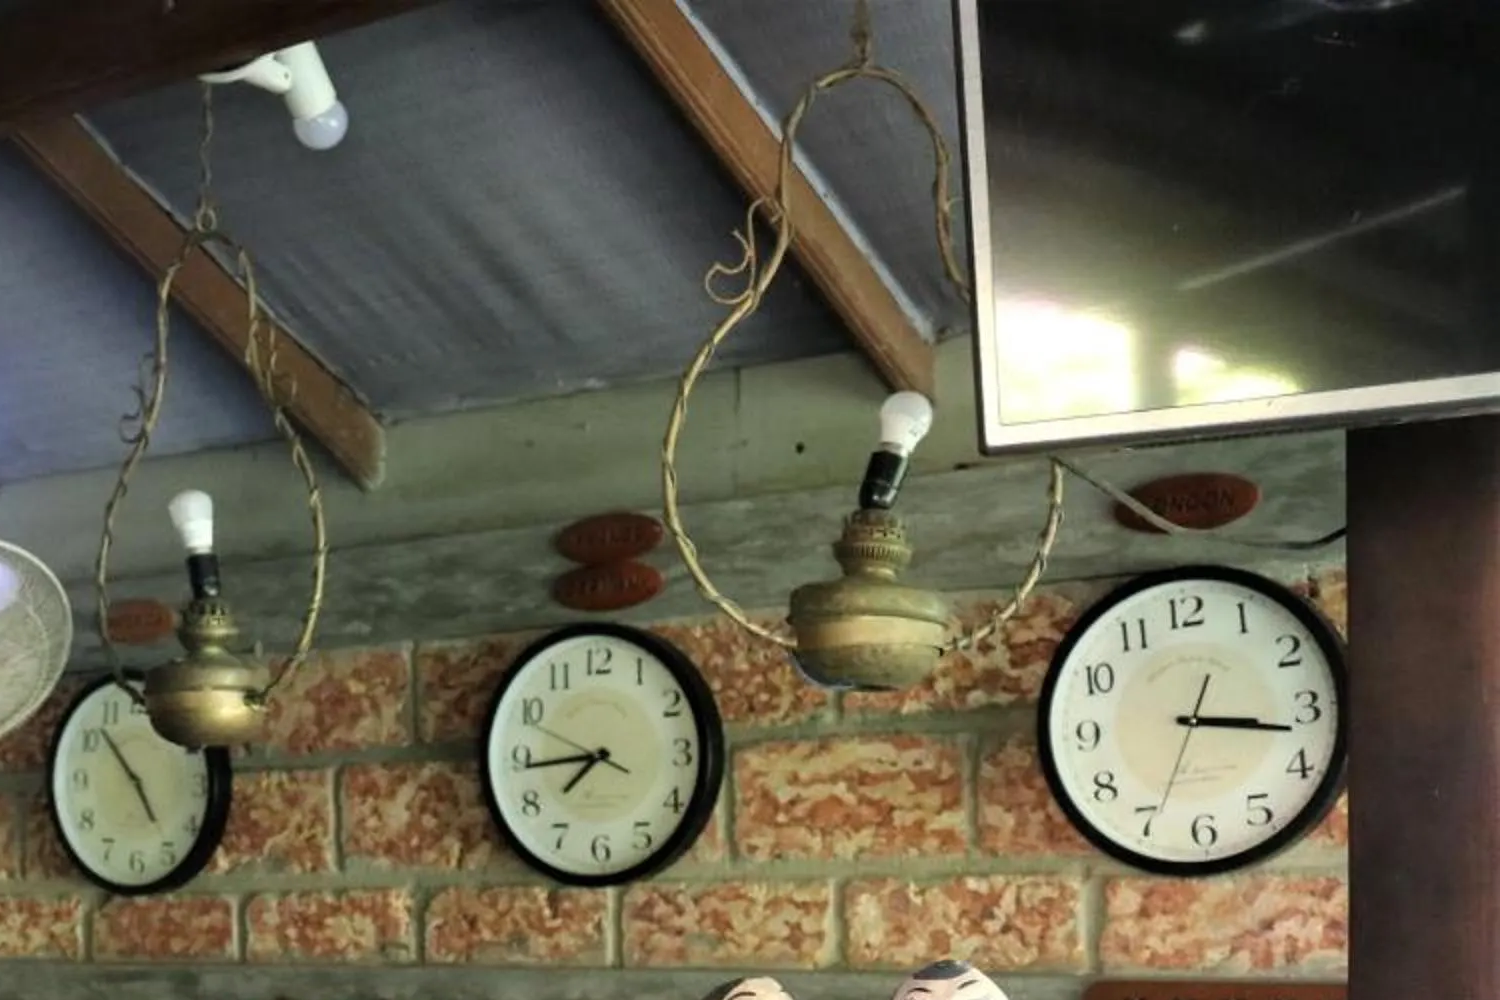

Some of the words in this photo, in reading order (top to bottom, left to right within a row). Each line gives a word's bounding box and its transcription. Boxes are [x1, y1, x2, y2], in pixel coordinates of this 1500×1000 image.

[1170, 596, 1204, 630] 12
[1237, 603, 1248, 634] 1
[1121, 618, 1148, 652] 11
[586, 649, 612, 676] 12
[1275, 634, 1302, 668] 2
[550, 663, 570, 691] 11
[636, 658, 644, 686] 1
[1086, 662, 1115, 695] 10
[103, 701, 118, 725] 11
[521, 698, 544, 726] 10
[662, 689, 681, 717] 2
[1294, 690, 1321, 724] 3
[83, 728, 99, 752] 10
[1076, 720, 1101, 752] 9
[511, 745, 532, 773] 9
[672, 738, 693, 767] 3
[1286, 749, 1314, 779] 4
[73, 769, 88, 790] 9
[1093, 770, 1119, 802] 8
[521, 790, 541, 817] 8
[663, 786, 684, 814] 4
[1246, 793, 1274, 827] 5
[79, 809, 95, 831] 8
[1135, 805, 1158, 837] 7
[1191, 814, 1218, 846] 6
[102, 838, 115, 861] 7
[551, 823, 569, 853] 7
[590, 834, 611, 863] 6
[632, 822, 652, 851] 5
[129, 851, 145, 874] 6
[160, 842, 176, 866] 5
